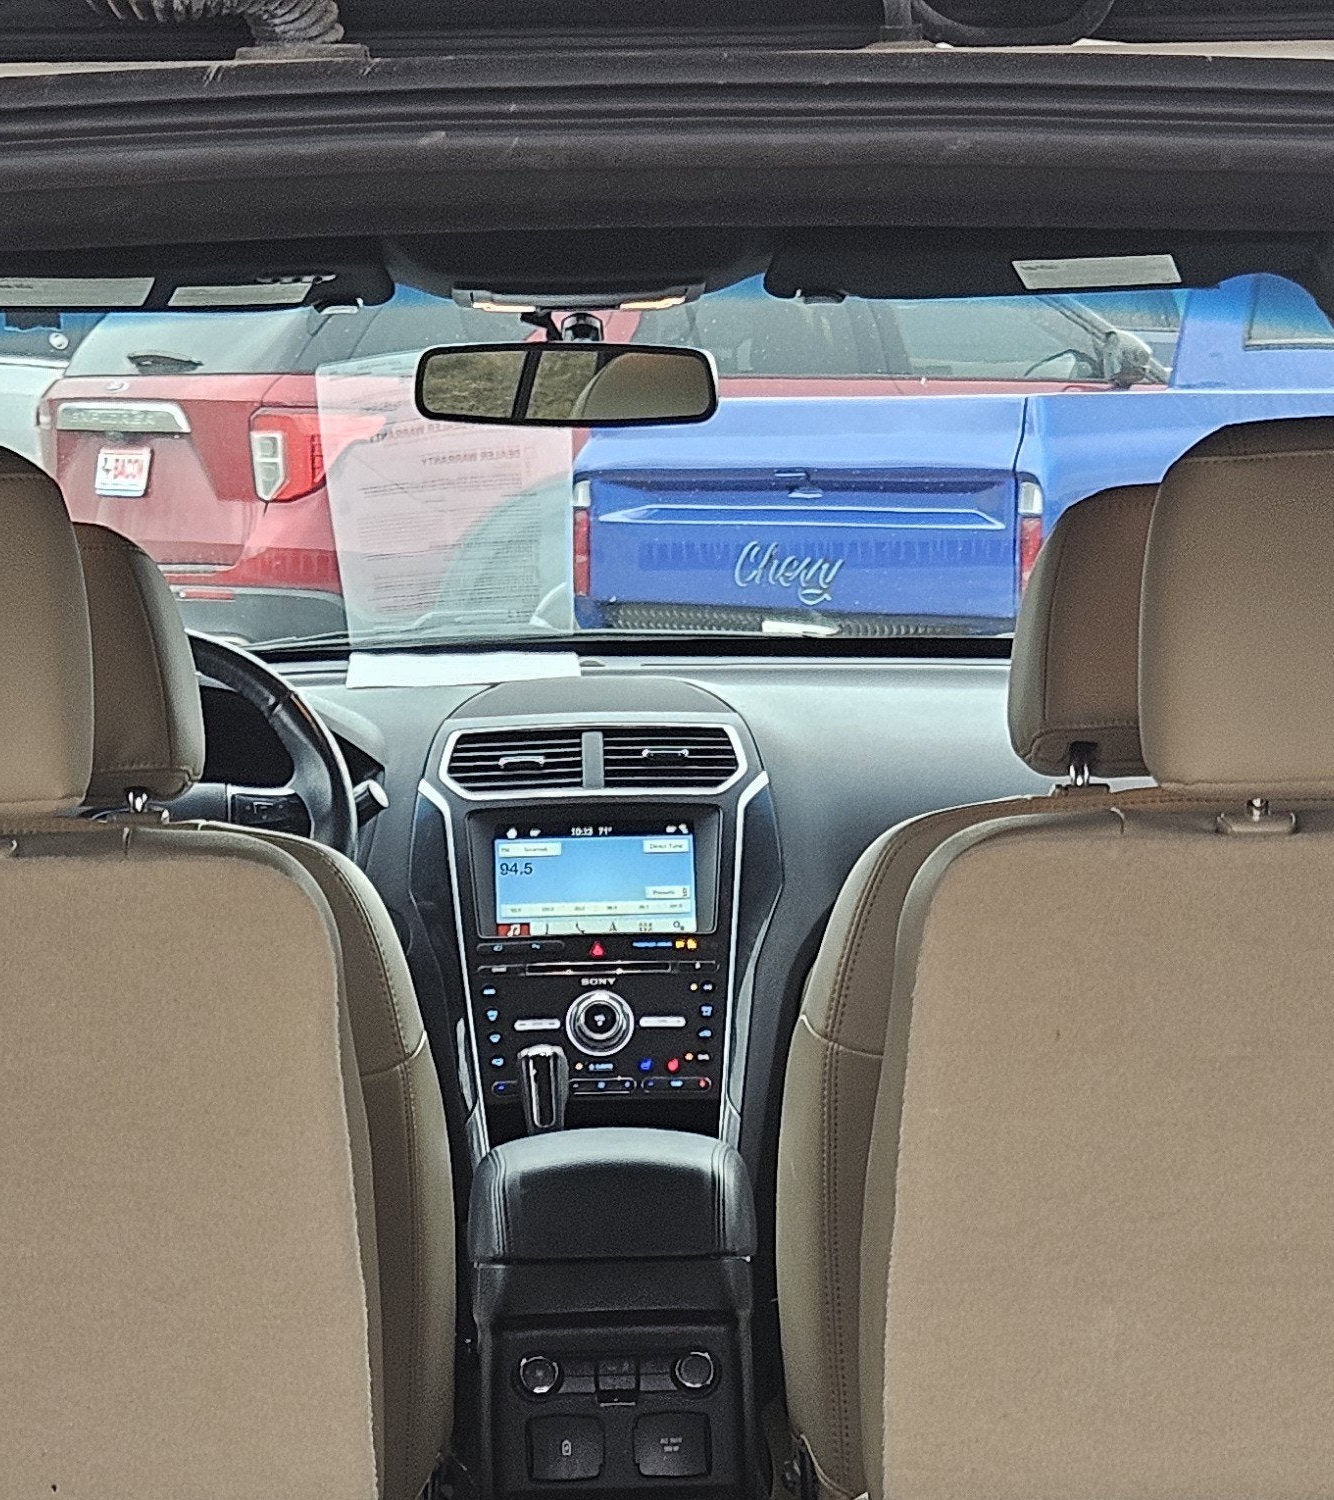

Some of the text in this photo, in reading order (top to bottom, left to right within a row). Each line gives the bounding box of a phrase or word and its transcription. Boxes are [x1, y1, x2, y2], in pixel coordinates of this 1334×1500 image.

[734, 540, 845, 606] Chevy
[499, 862, 533, 876] 94.5
[580, 977, 616, 987] SONY
